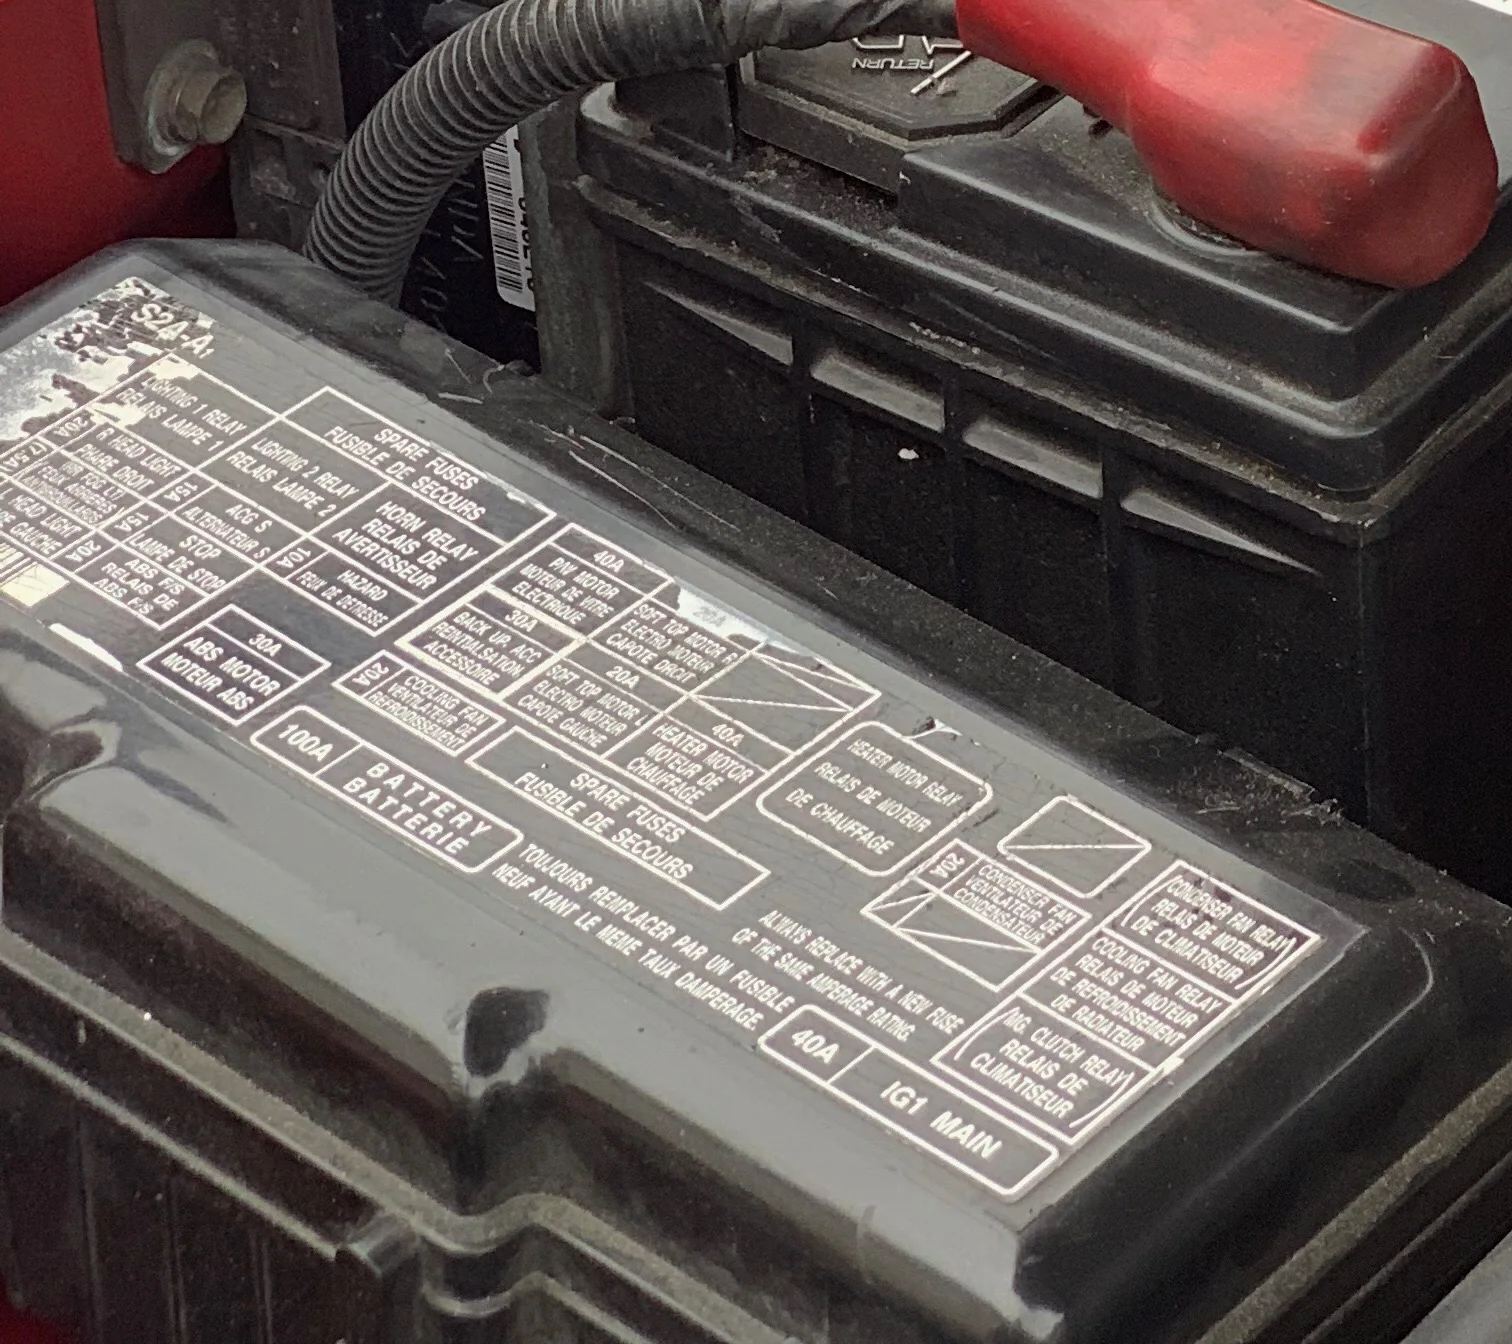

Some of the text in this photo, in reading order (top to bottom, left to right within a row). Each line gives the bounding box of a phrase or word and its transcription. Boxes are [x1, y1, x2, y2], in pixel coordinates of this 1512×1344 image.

[851, 56, 935, 71] RETURN
[226, 450, 337, 517] RELAIS LAMPE 2
[251, 437, 360, 499] LIGHTING 2 RELAY
[324, 426, 486, 521] FUSIBLE DE SECOURS
[374, 428, 479, 490] SPARE FUSES
[163, 482, 198, 502] 15A
[225, 504, 273, 533] ACG S
[179, 534, 222, 559] STOP
[332, 528, 437, 590] AVERTISSEUR
[361, 518, 447, 571] RELAIS DE
[375, 501, 479, 561] HORN RELAY
[101, 562, 179, 611] RELAIS DE
[337, 569, 388, 601] HAZARD
[593, 551, 625, 573] 40A
[248, 633, 282, 657] 30A
[504, 609, 538, 632] 30A
[161, 652, 254, 710] MOTEUR ABS
[183, 636, 280, 696] ABS MOTOR
[605, 665, 640, 689] 20A
[404, 675, 489, 726] COOLING FAN
[278, 724, 333, 762] 100A
[652, 723, 754, 784] HEATER MOTOR
[712, 724, 744, 747] 40A
[627, 757, 705, 805] CHAUFFAGE
[645, 742, 724, 792] MOTEUR DE
[343, 777, 469, 854] BATTERIE
[366, 762, 492, 837] BATTERY
[514, 772, 693, 879] FUSIBLE DE SECOURS
[570, 773, 686, 843] SPARE FUSES
[785, 788, 894, 855] DE CHAUFFAGE
[814, 762, 932, 833] RELAIS DE MOTEUR
[519, 843, 795, 1013] TOUJOURS REMPLACER PAR UN FUSIBLE
[1130, 915, 1243, 983] DE CLIMATISEUR
[1150, 898, 1264, 966] RELAIS DE MOTEUR
[731, 927, 758, 945] OF
[750, 937, 782, 961] THE
[773, 952, 814, 981] SAME
[806, 973, 874, 1016] AMPERAGE
[758, 910, 964, 1034] ALWAYS REPLACE WITH A NEW FUSE
[1075, 954, 1198, 1028] RELAIS DE MOTEUR
[1092, 936, 1223, 1014] COOLING FAN RELAY
[1050, 966, 1186, 1046] DE REFROIDISSEMENT
[1050, 994, 1145, 1052] DE RADIATEUR
[791, 1030, 839, 1064] 40A
[999, 1039, 1088, 1096] RELAIS DE
[1030, 1027, 1085, 1063] CLUTCH
[1079, 1054, 1130, 1087] RELAY
[970, 1053, 1074, 1118] CLIMATISEUR
[880, 1081, 1002, 1158] IG1 MAIN
